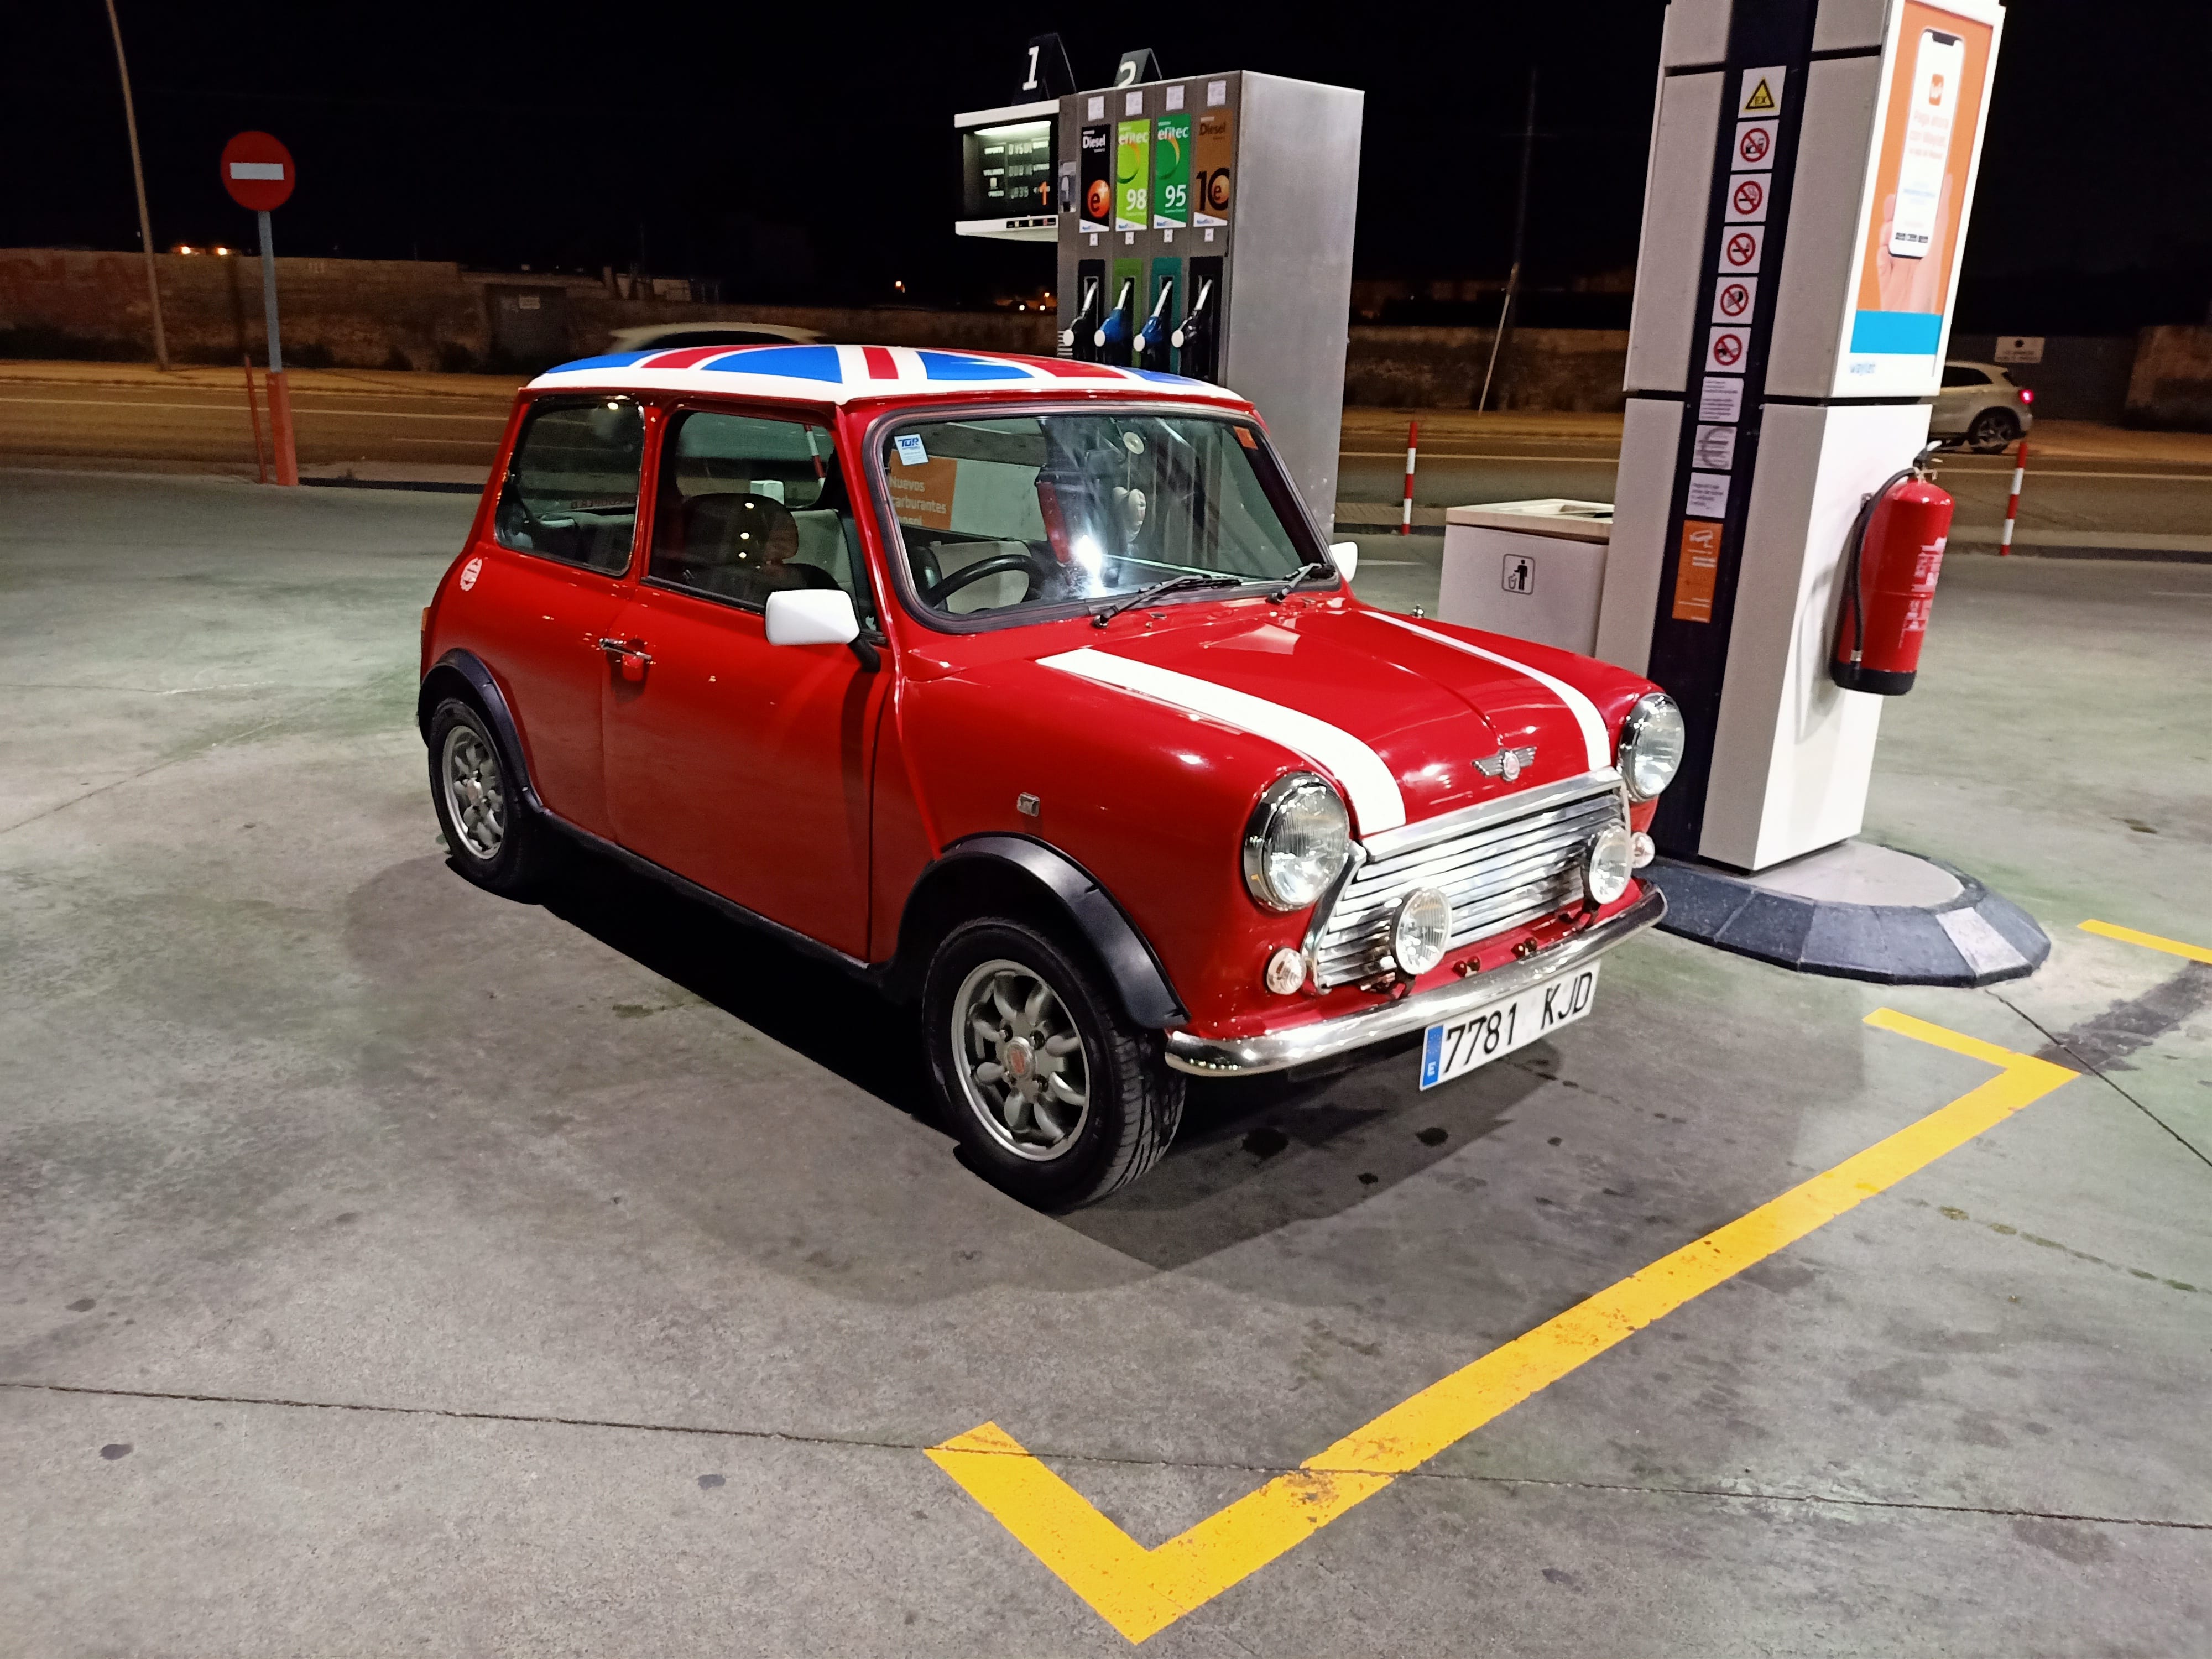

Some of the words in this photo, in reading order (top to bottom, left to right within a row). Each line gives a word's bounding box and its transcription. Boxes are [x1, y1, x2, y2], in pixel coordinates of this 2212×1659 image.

[1022, 46, 1039, 91] 1
[1118, 61, 1136, 89] 2
[1200, 122, 1226, 136] Diesel
[1083, 133, 1105, 149] Diesel
[1126, 189, 1146, 211] 98
[1165, 184, 1186, 208] 95
[1443, 1002, 1517, 1074] 7781
[1540, 972, 1593, 1030] KJD
[1427, 1062, 1437, 1077] E
